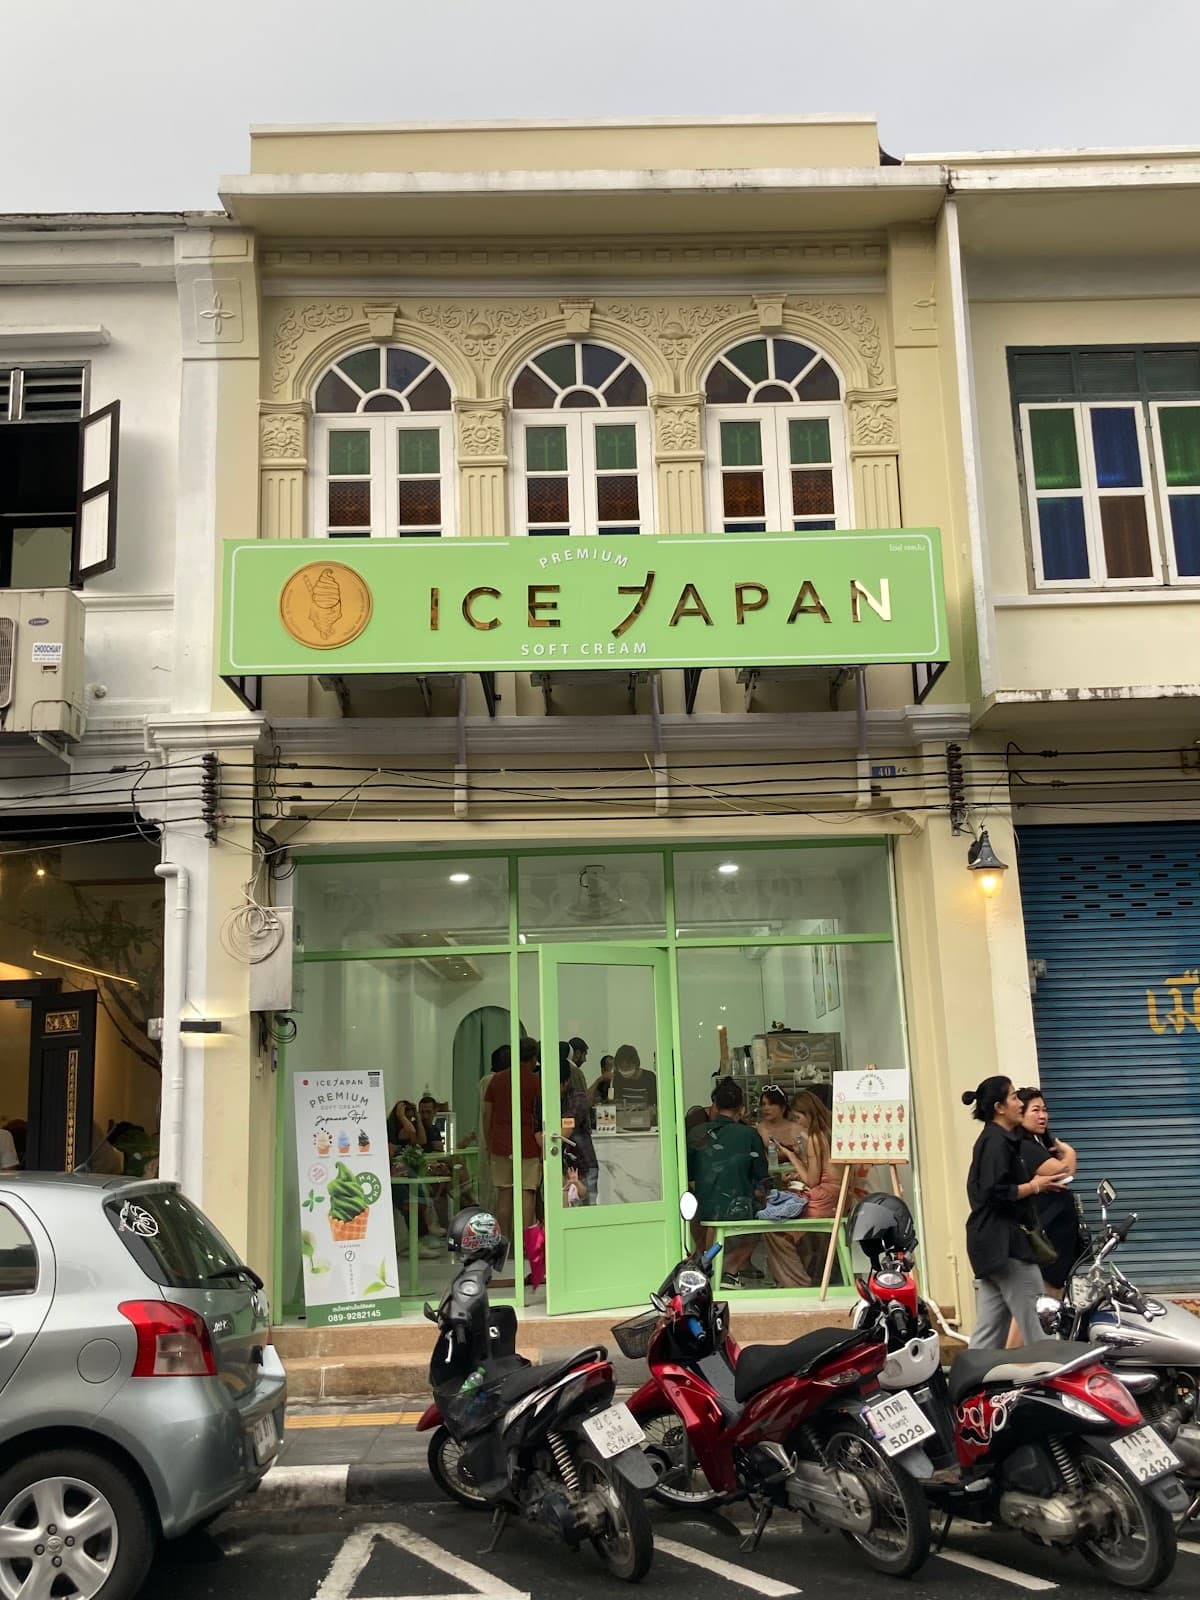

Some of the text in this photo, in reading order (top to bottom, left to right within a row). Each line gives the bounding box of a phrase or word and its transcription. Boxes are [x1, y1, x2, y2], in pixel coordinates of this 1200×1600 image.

[539, 549, 629, 569] PREMIUM
[430, 584, 561, 631] ICE
[521, 642, 648, 656] SOFT CREAM
[309, 1091, 369, 1108] PREMIUM
[359, 1175, 380, 1202] MATCHA
[327, 1309, 382, 1322] 089-9282145
[889, 1425, 925, 1449] 5029
[1139, 1455, 1172, 1479] 2432
